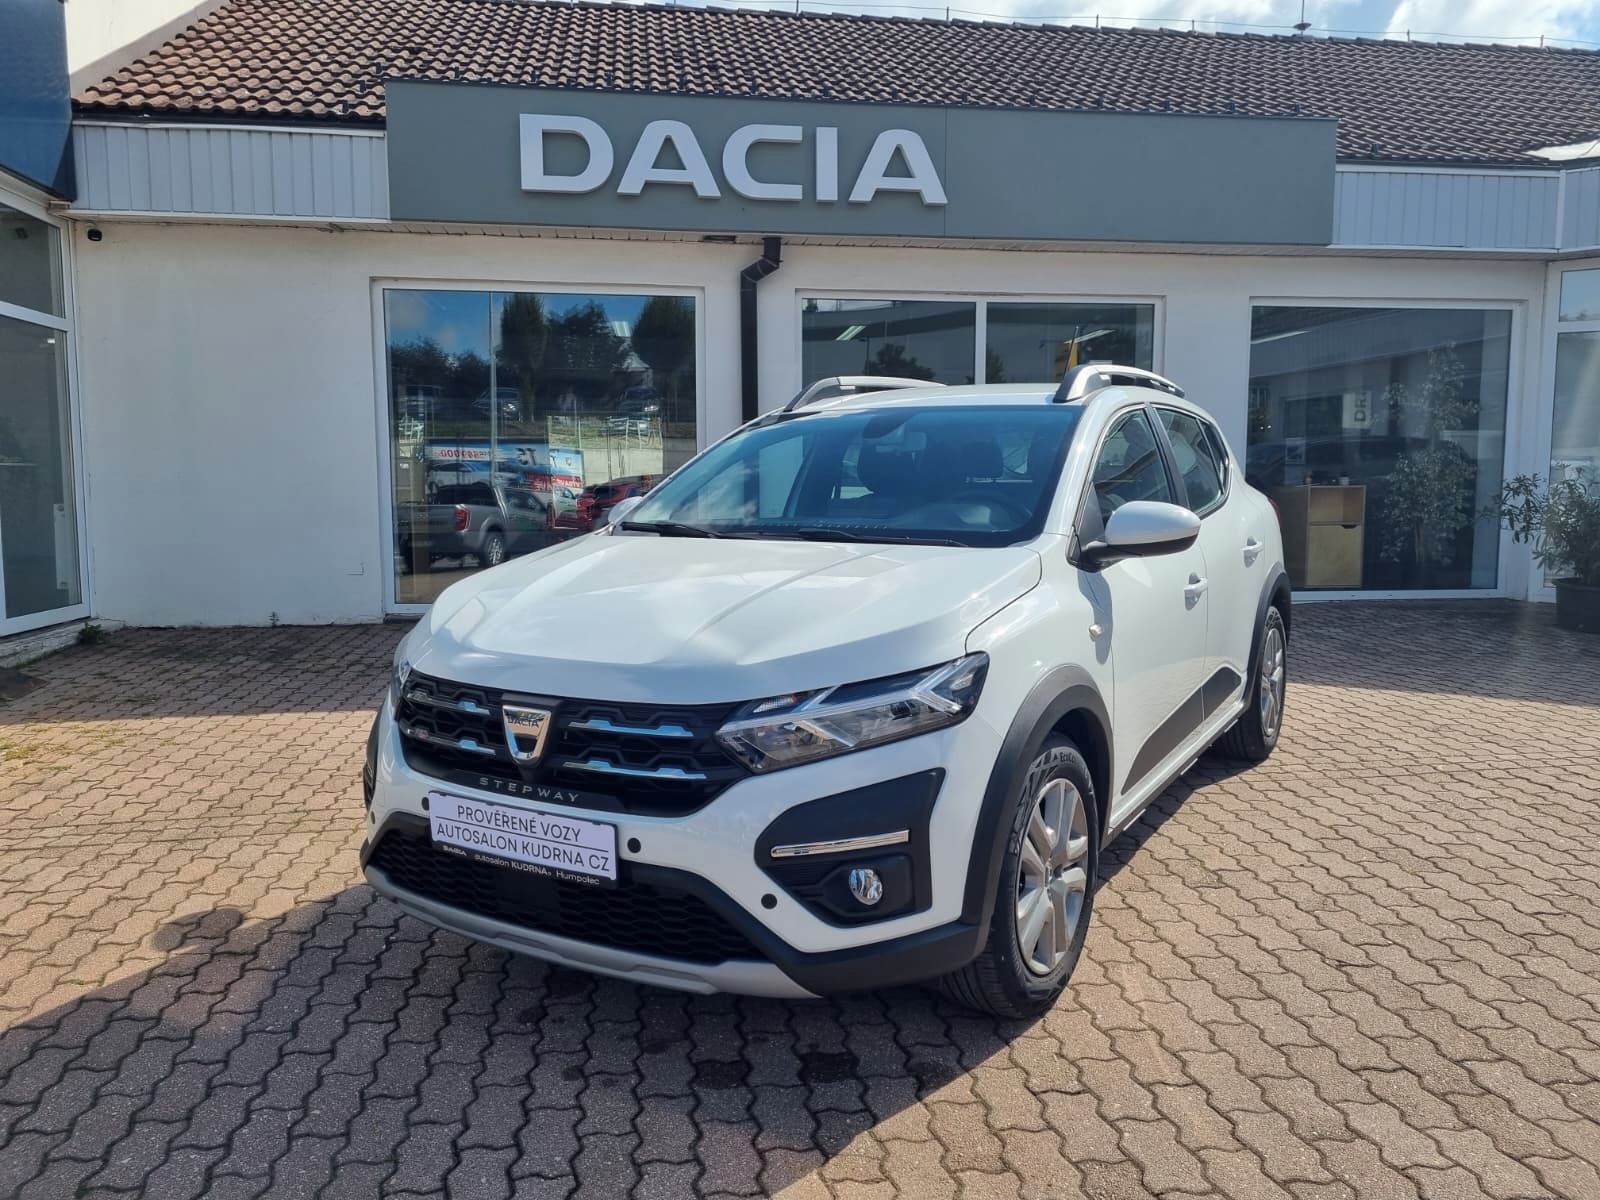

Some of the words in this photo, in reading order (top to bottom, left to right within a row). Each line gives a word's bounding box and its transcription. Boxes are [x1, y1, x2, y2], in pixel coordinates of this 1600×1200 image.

[519, 113, 948, 206] DACIA
[479, 777, 579, 802] STEPWAY
[540, 821, 581, 842] VOZY
[436, 822, 518, 853] AUTOSALON
[521, 840, 585, 867] KUDRNA
[588, 854, 610, 872] CZ
[556, 869, 600, 886] Humpolec
